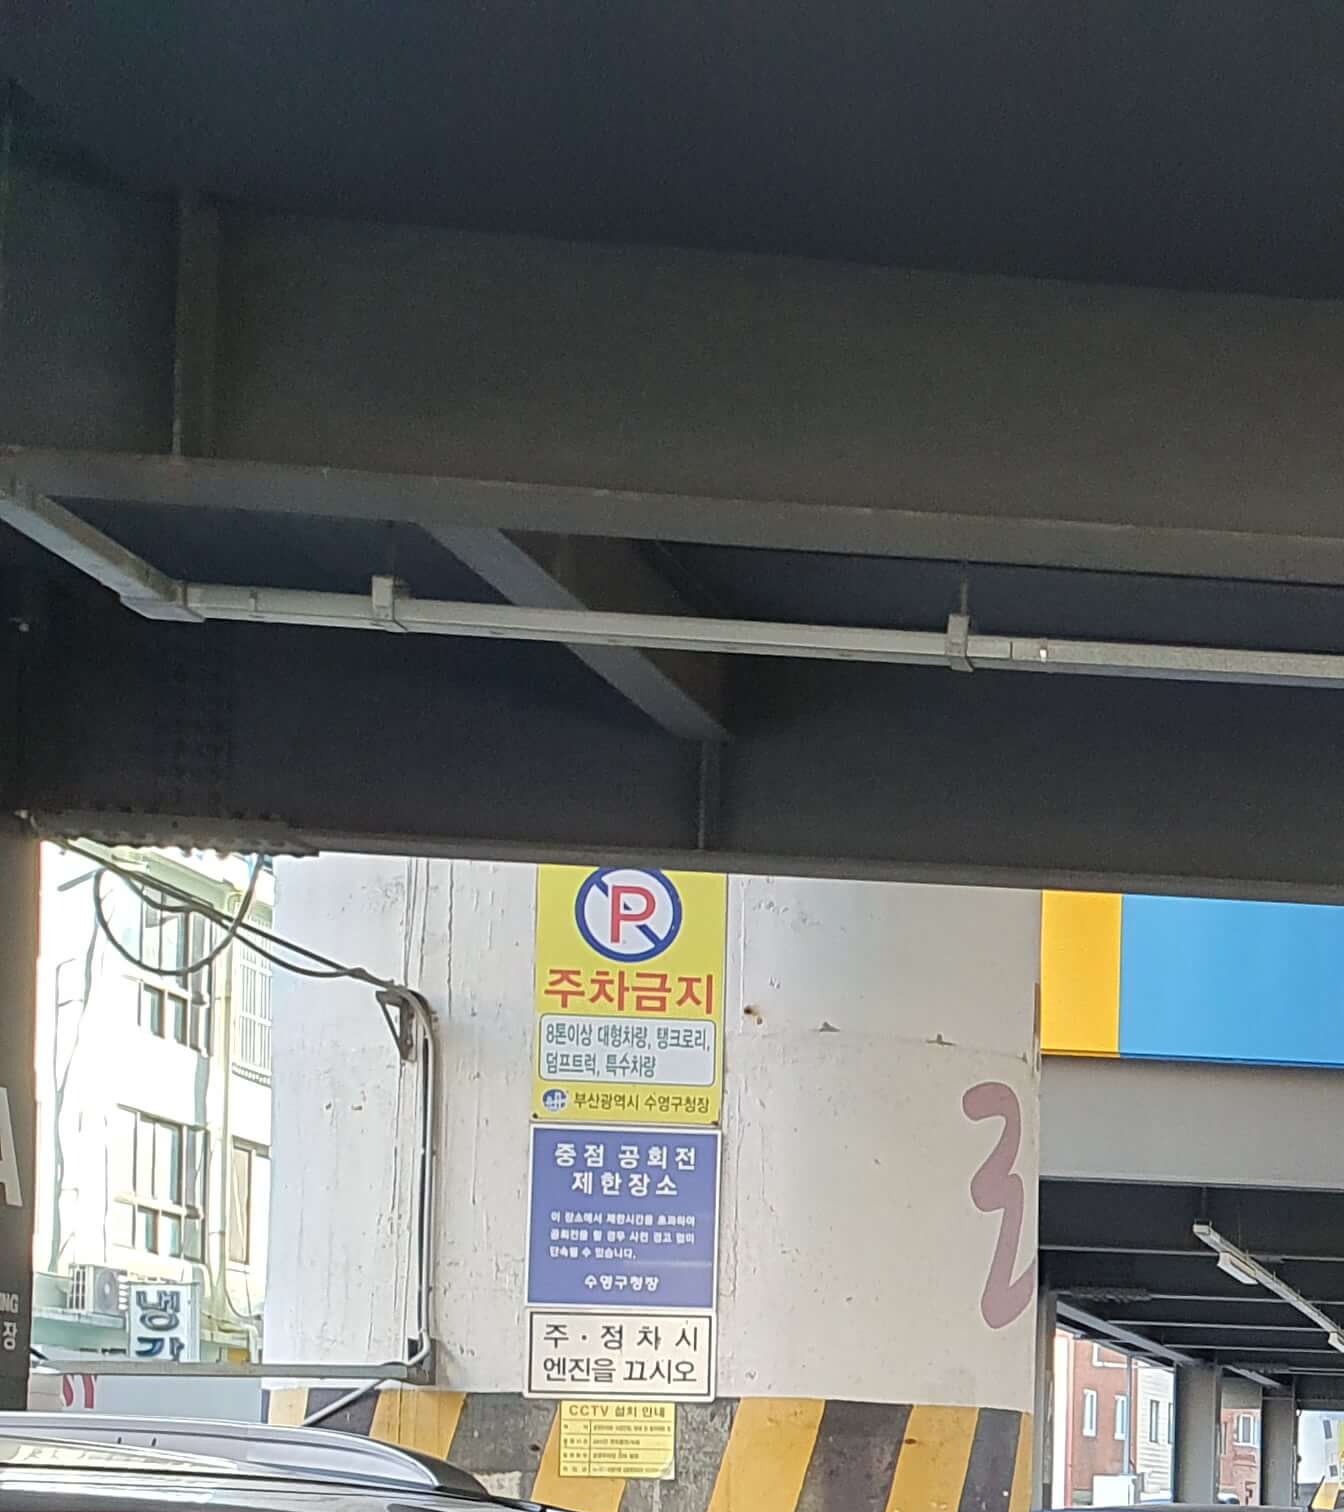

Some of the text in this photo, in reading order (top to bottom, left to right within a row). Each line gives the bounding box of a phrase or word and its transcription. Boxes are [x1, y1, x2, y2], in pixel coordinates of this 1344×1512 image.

[543, 967, 715, 1015] 주차금지
[605, 1052, 657, 1078] 특수차량
[573, 1091, 710, 1114] 부산광역시 수영구청장
[554, 1143, 697, 1171] 중점 공회전
[571, 1172, 680, 1197] 제한장소
[542, 1356, 698, 1385] 엔진을 끄시오
[569, 1404, 609, 1417] CCTV
